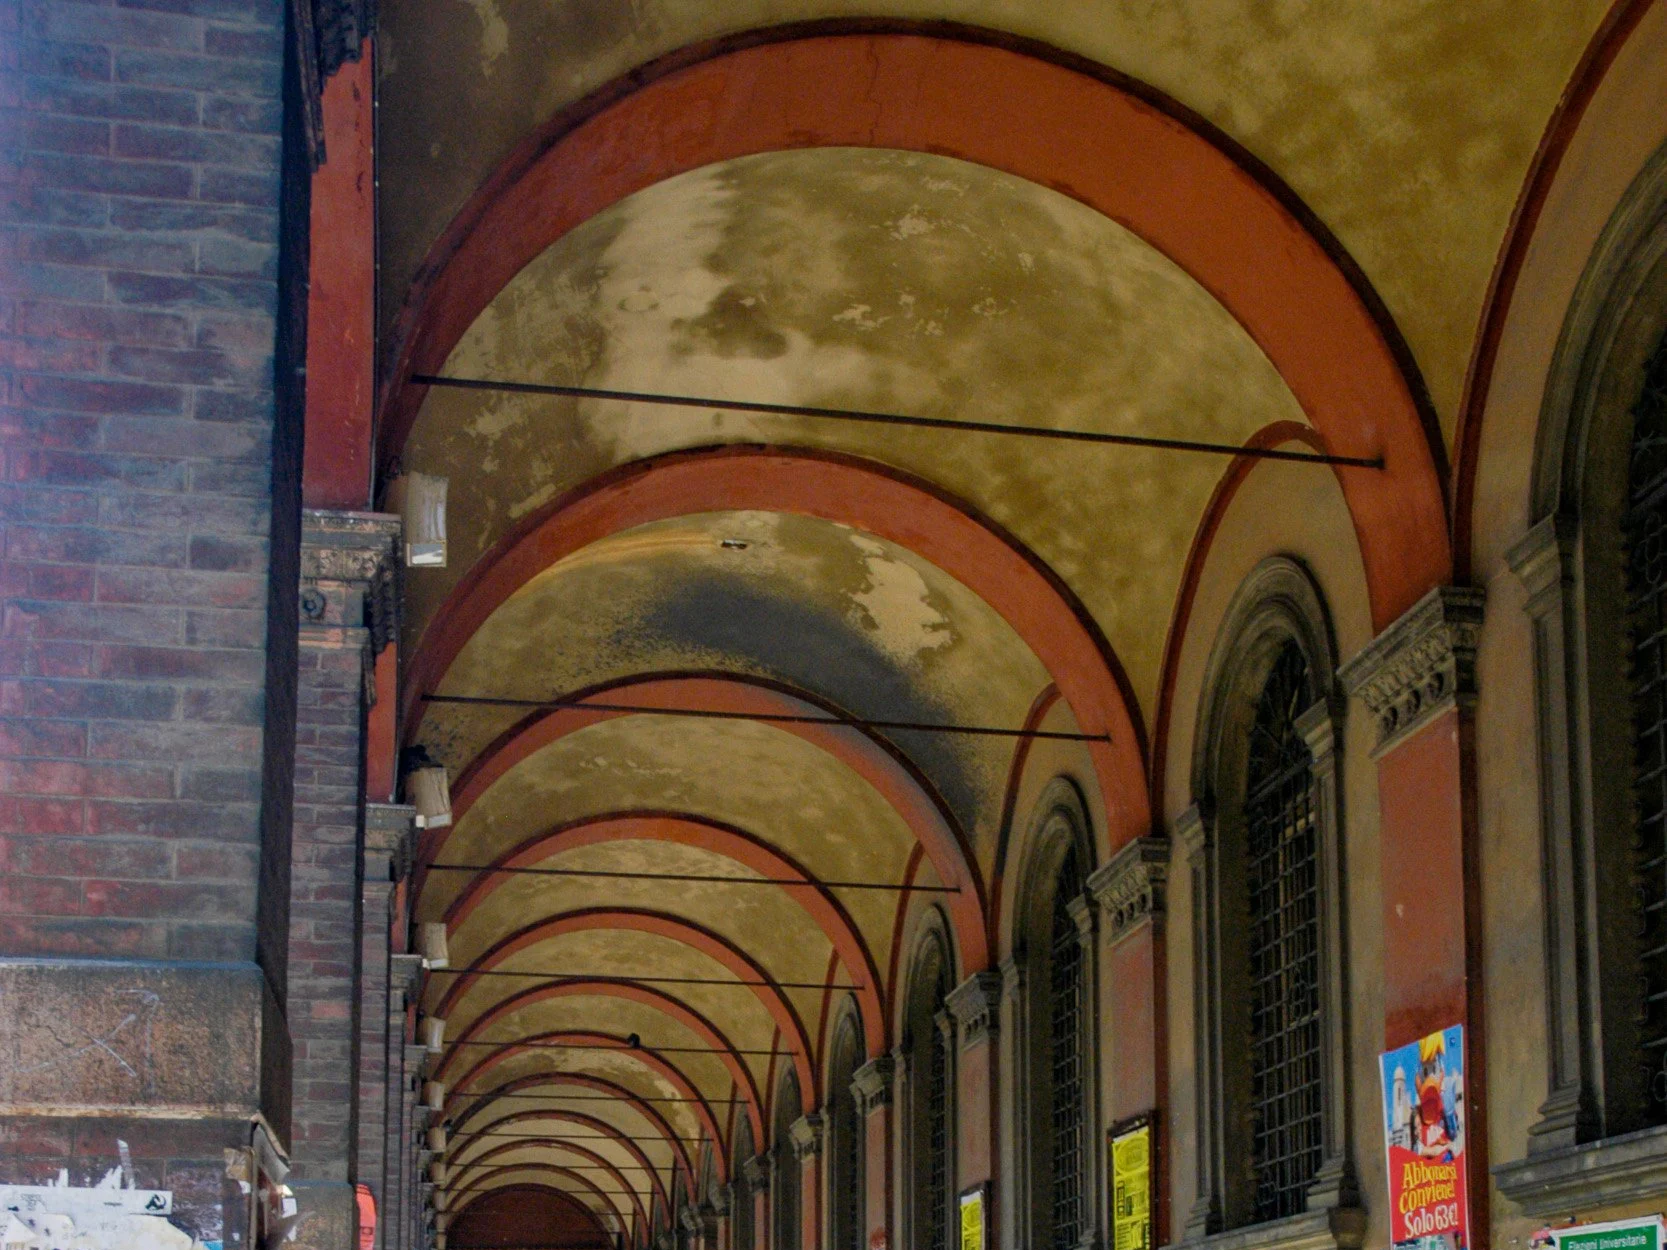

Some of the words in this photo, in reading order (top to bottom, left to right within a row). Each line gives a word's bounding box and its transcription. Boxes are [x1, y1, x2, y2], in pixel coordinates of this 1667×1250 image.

[1402, 1162, 1457, 1189] Abbonarsi
[1404, 1209, 1433, 1238] Solo
[1600, 1234, 1647, 1250] Universitarie
